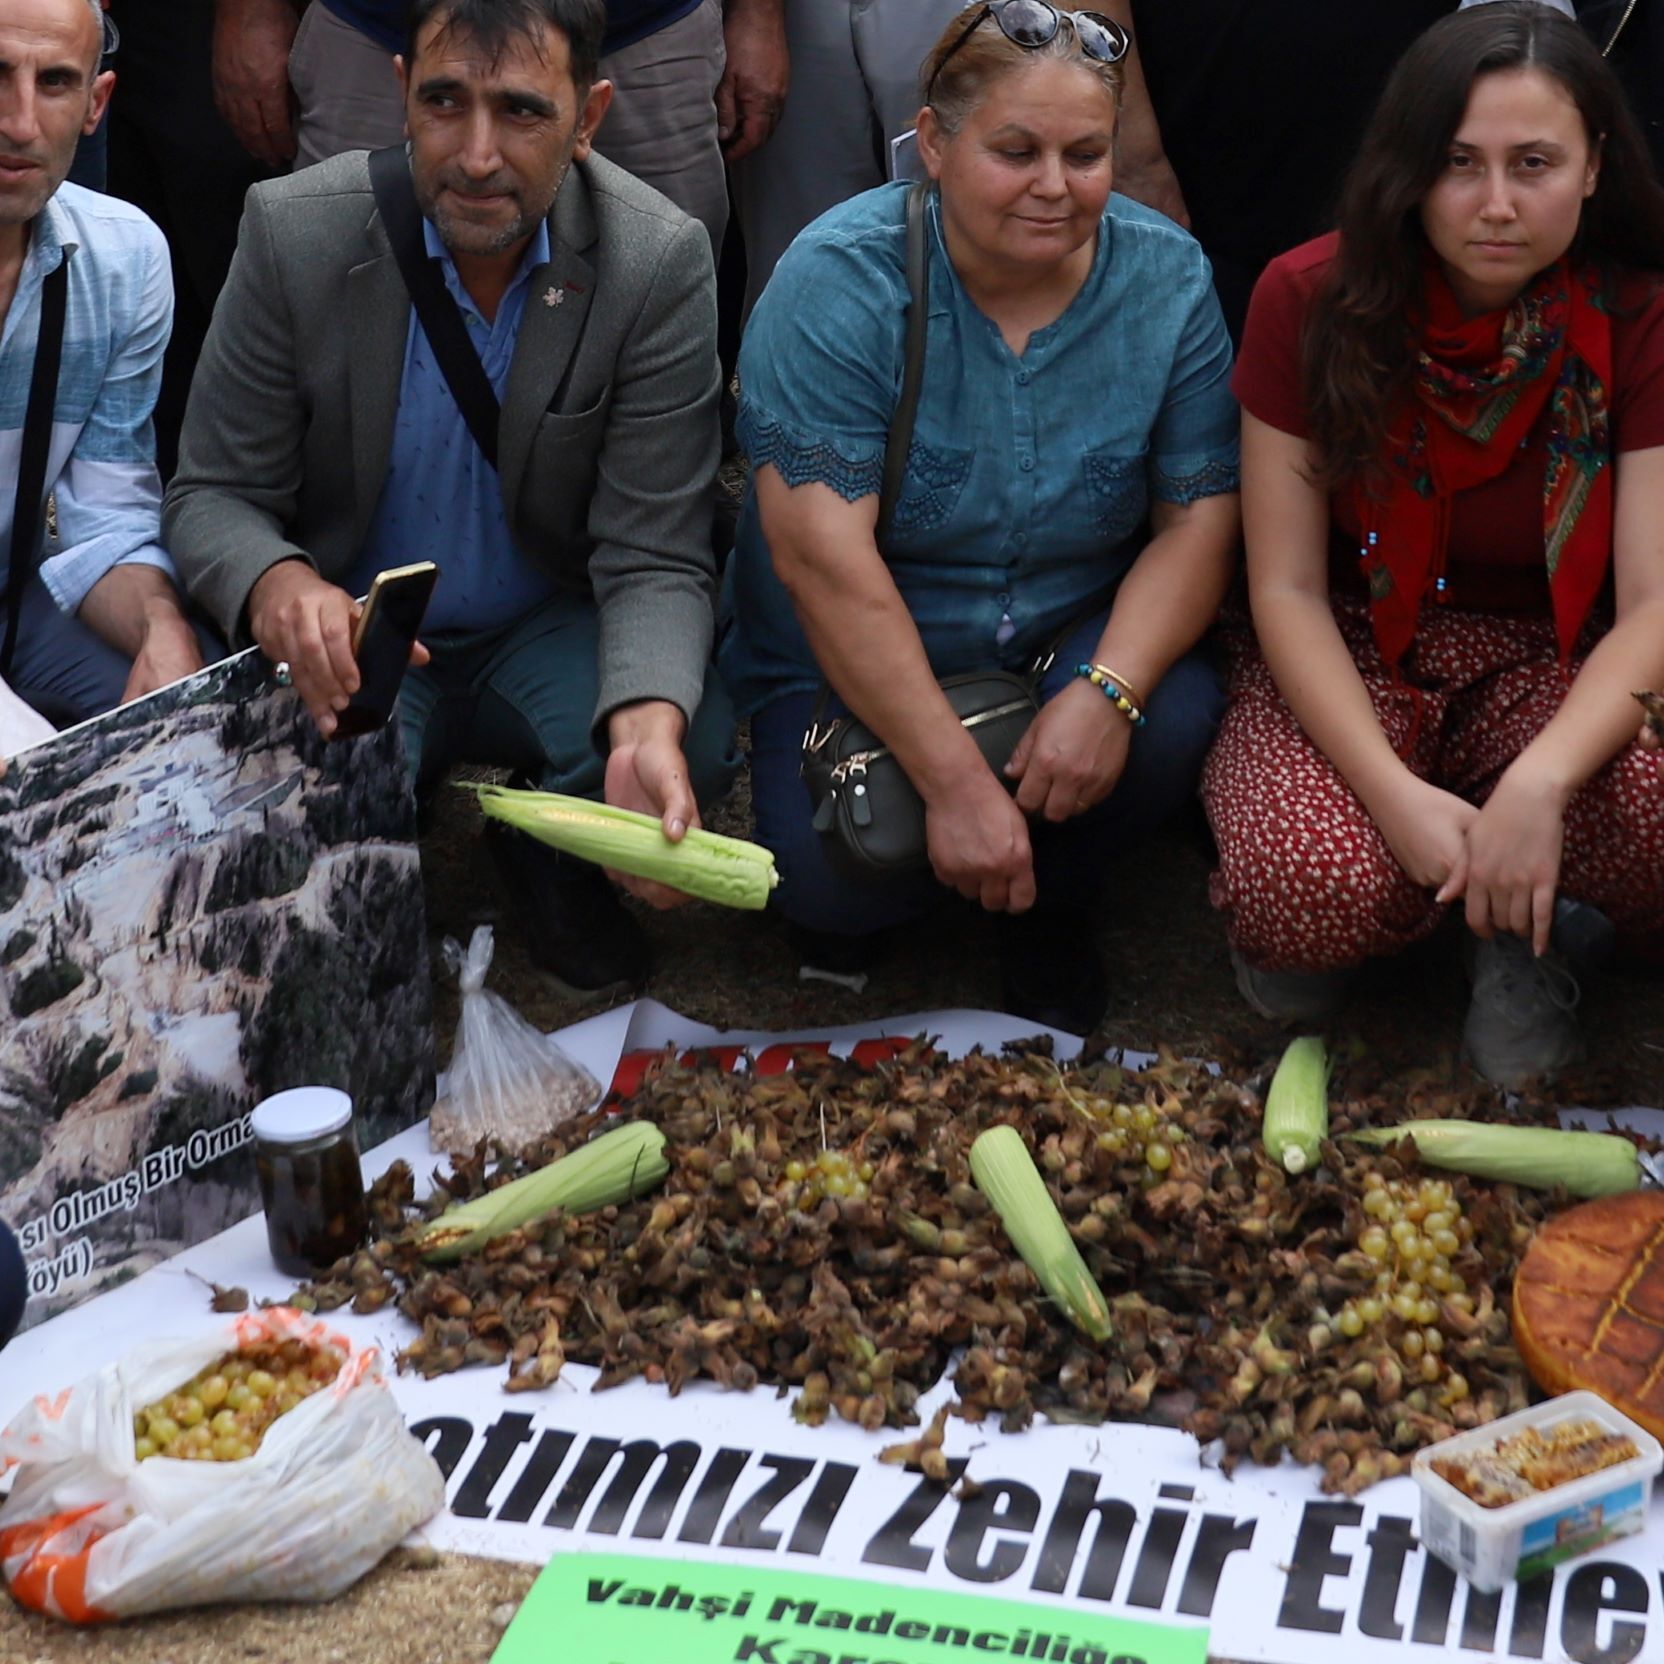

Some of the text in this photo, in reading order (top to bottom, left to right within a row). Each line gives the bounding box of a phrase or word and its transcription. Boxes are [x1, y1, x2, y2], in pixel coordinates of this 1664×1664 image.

[52, 1174, 142, 1236] Olmuş
[142, 1143, 187, 1194] Bir
[584, 1577, 755, 1623] Vahşi
